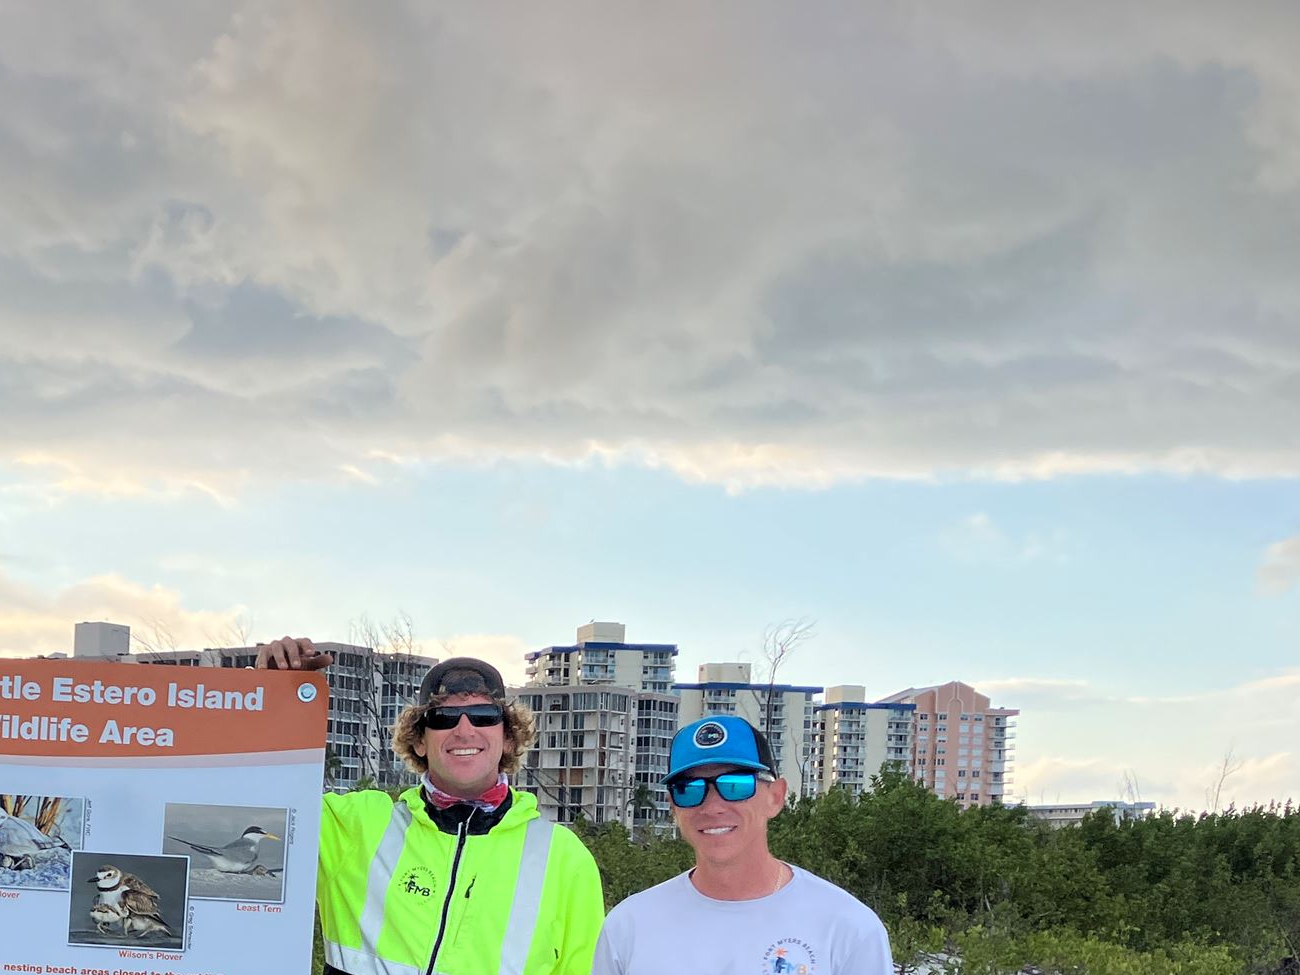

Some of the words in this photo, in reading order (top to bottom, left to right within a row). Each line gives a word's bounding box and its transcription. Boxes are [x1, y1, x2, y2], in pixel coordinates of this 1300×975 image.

[53, 678, 156, 706] Estero
[168, 683, 263, 711] Island
[99, 720, 173, 746] Area
[408, 886, 431, 896] FMB
[237, 904, 260, 912] Least
[119, 951, 153, 959] Wilson's
[156, 952, 182, 961] Plover
[4, 964, 42, 974] nesting
[46, 965, 77, 975] beach
